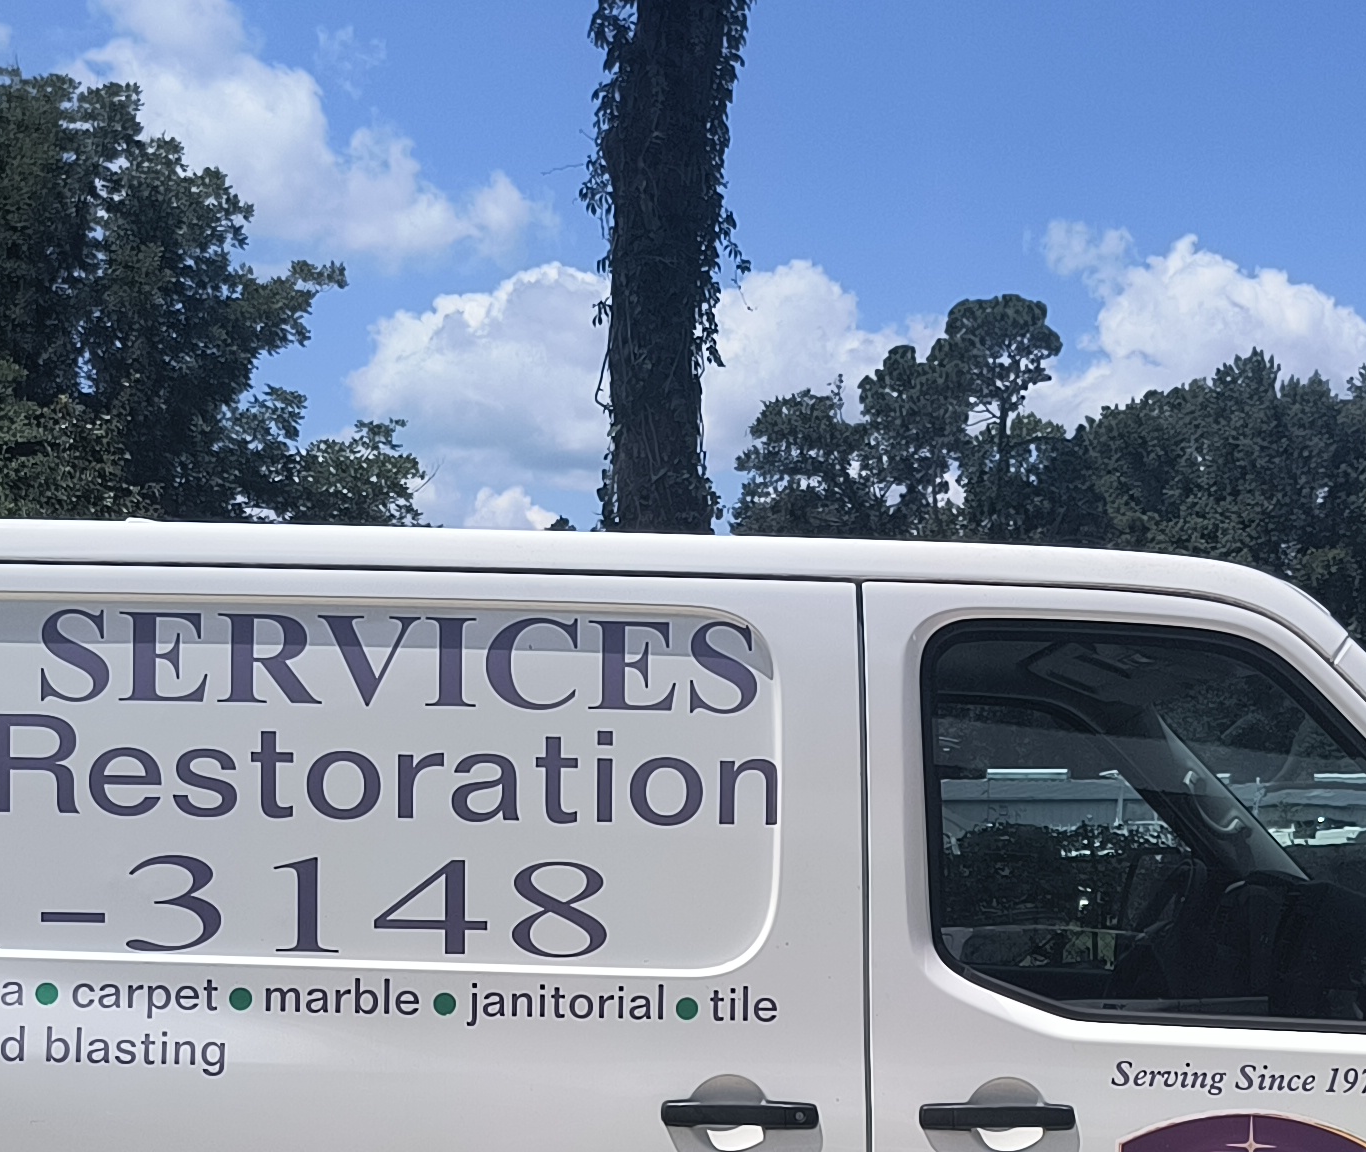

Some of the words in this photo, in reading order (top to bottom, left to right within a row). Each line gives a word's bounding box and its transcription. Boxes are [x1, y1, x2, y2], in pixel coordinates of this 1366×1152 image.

[39, 608, 759, 716] SERVICES
[71, 979, 219, 1015] carpet
[263, 978, 420, 1016] marble
[467, 981, 664, 1025] janitorial
[709, 984, 778, 1022] tile
[45, 1027, 226, 1077] blasting
[1111, 1059, 1226, 1095] Serving
[1235, 1063, 1317, 1095] Since
